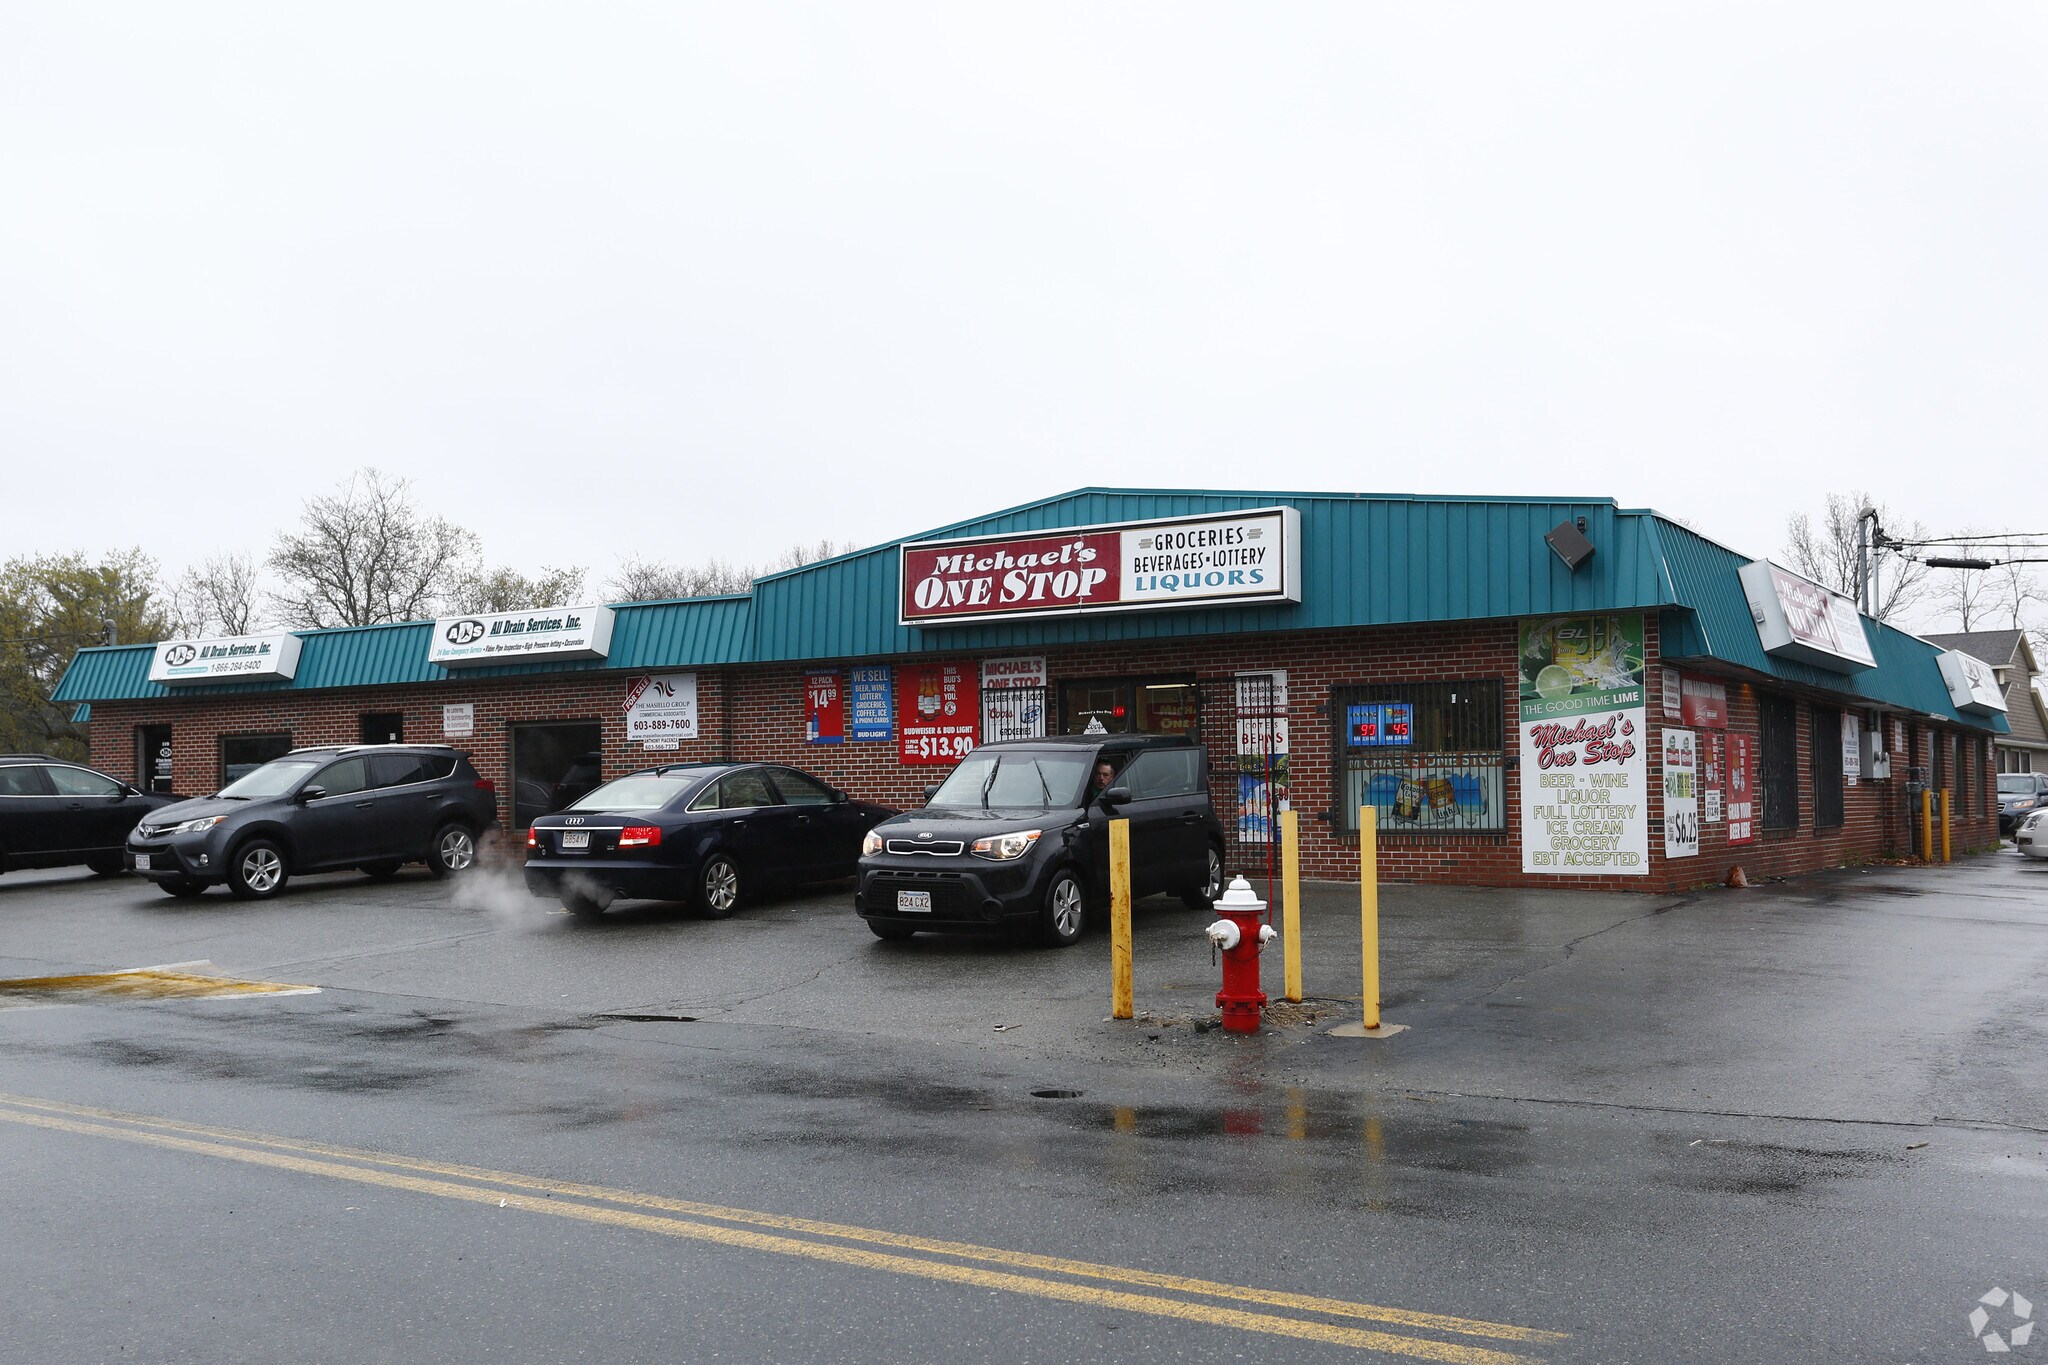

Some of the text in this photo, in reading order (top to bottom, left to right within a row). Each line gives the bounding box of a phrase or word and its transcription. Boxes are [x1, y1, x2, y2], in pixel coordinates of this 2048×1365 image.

[1154, 527, 1244, 551] GROCERIES
[932, 541, 1097, 576] Michael's
[1134, 546, 1266, 574] BEVERAGES LOTTERY
[1136, 568, 1264, 592] LIQUORS
[914, 566, 1108, 609] ONE STOP
[490, 621, 502, 635] All
[504, 619, 525, 634] Drain
[565, 614, 581, 628] Inc.
[200, 646, 209, 658] All
[210, 645, 227, 658] Drain
[258, 641, 271, 654] Inc.
[211, 661, 261, 673] 1-866-284-6400
[944, 667, 957, 675] THIS
[985, 661, 1042, 675] MICHAEL'S
[818, 676, 832, 684] PACK
[853, 669, 888, 682] WE SELL
[944, 675, 961, 683] BUD'S
[1012, 677, 1040, 688] STOP
[625, 679, 650, 710] FOR SALE
[871, 683, 887, 692] WINE,
[944, 684, 956, 692] FOR
[859, 692, 883, 701] LOTTERY,
[1524, 691, 1639, 715] THE GOOD TIME LIME
[856, 701, 887, 709] GROCERIES,
[856, 709, 887, 717] COFFEE, ICE
[634, 719, 691, 731] 603-889-7600
[904, 727, 936, 735] BUDWEISER
[943, 726, 955, 734] BUD
[1393, 723, 1408, 735] 45
[1530, 712, 1635, 748] Michael's
[1242, 732, 1284, 744] BEANS
[920, 735, 973, 759] $13.90
[1462, 752, 1501, 765] STOP
[1538, 740, 1635, 770] One Stop
[1540, 773, 1575, 788] BEER
[1589, 773, 1628, 788] WINE
[1557, 789, 1610, 804] LIQUOR
[1533, 805, 1637, 819] FULL LOTTERY
[1728, 802, 1752, 820] GRAB YOUR
[1546, 820, 1623, 835] ICE CREAM
[1676, 810, 1697, 847] $6.25
[1729, 821, 1751, 840] BEER HERE
[1551, 836, 1620, 850] GROCERY
[1533, 851, 1640, 866] EBT ACCEPTED
[899, 896, 929, 907] 824 CX2
